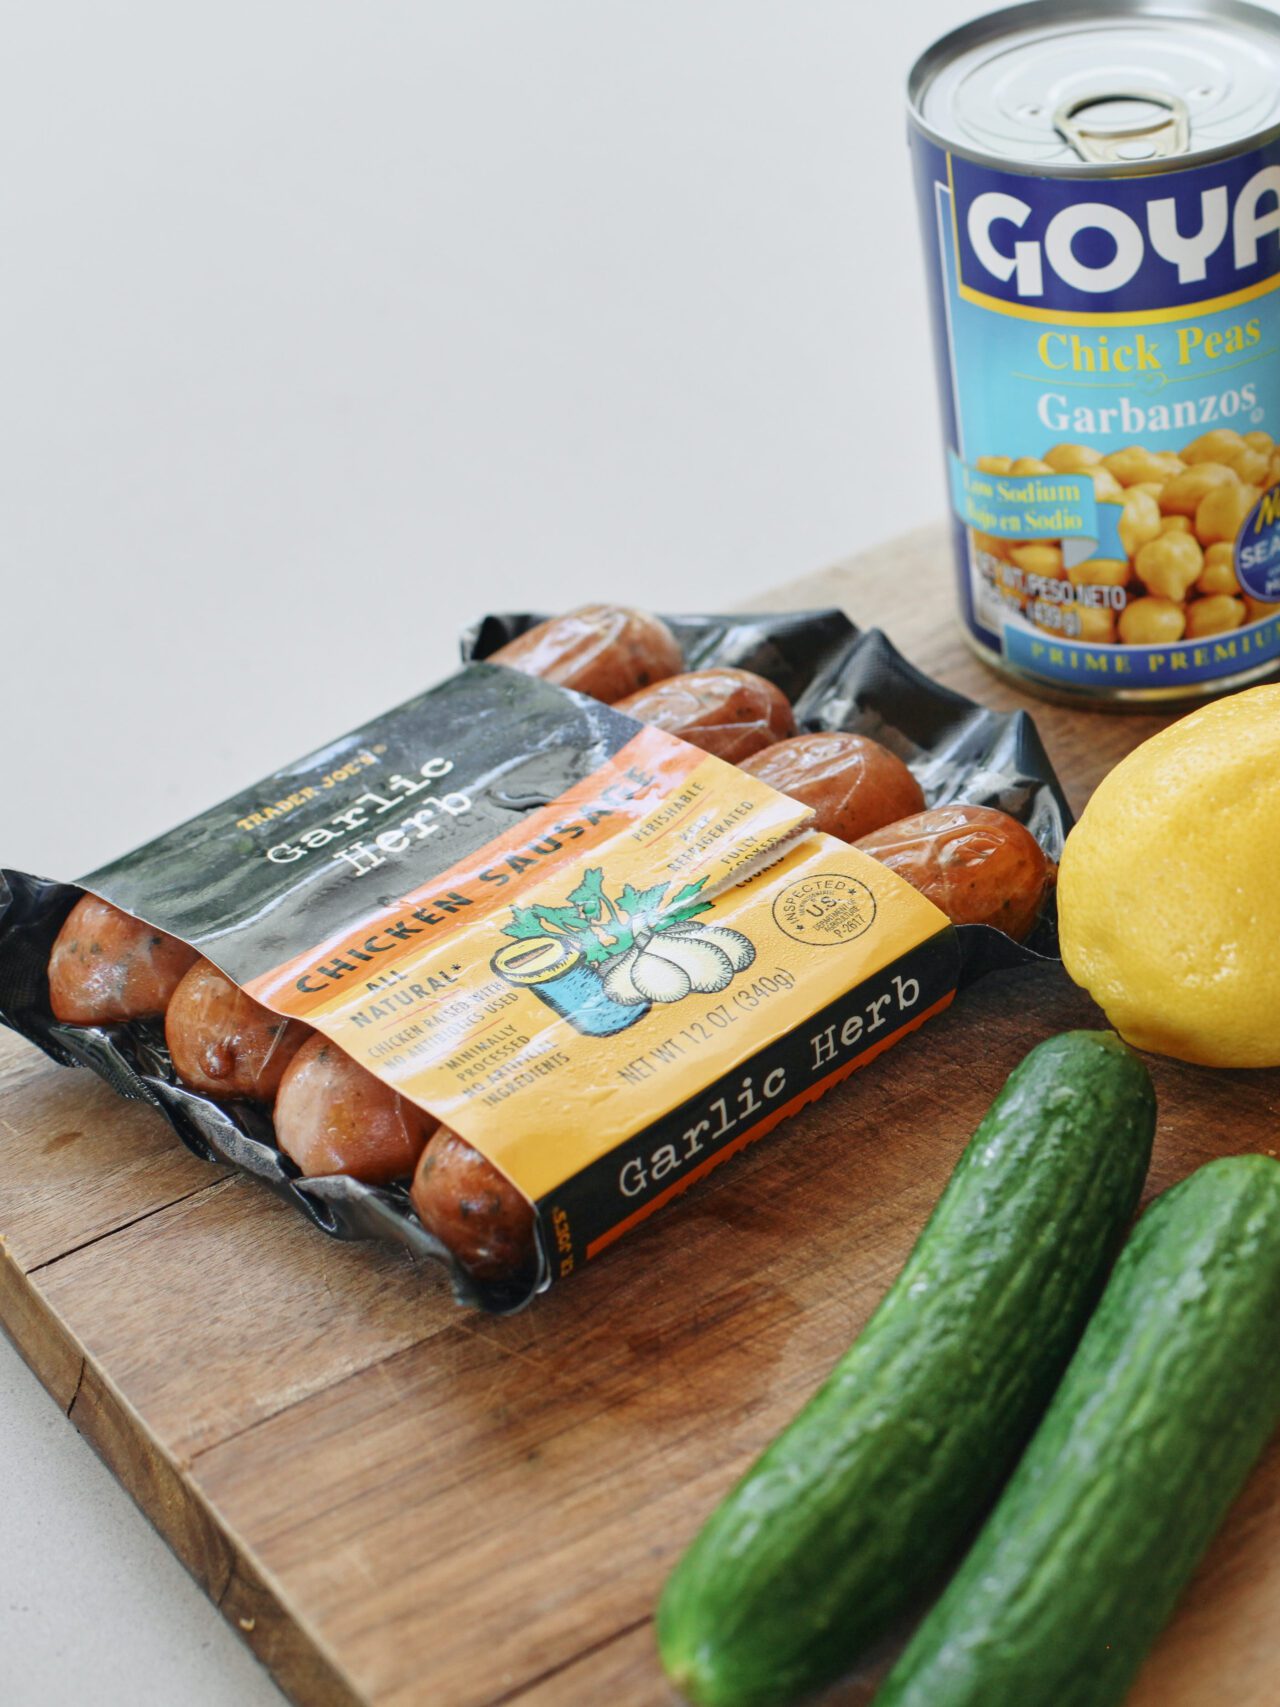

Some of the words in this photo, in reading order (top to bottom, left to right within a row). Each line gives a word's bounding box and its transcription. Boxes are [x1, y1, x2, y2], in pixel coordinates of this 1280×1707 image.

[1038, 331, 1160, 373] Chick
[1178, 317, 1262, 365] Peas
[1037, 382, 1257, 434] Garbanzos
[996, 481, 1080, 503] Sodium
[1024, 509, 1082, 531] Sodio
[1077, 582, 1127, 611] NETO
[1031, 641, 1131, 673] PRIME
[236, 785, 321, 832] TRADER
[266, 757, 454, 865] Garlic
[333, 790, 472, 877] Herb
[631, 782, 705, 842] PERISHABLE
[667, 801, 754, 872] REFRIGERATED
[721, 835, 758, 865] FULLY
[295, 891, 474, 994] CHICKEN
[479, 766, 654, 888] SAUSAGE
[783, 880, 846, 925] INSPECTED
[806, 896, 841, 917] U.S.
[366, 970, 408, 993] ALL
[367, 1025, 424, 1059] CHICKEN
[423, 1001, 471, 1029] RAISED
[468, 979, 507, 1003] WITH
[384, 1055, 406, 1071] NO
[408, 1013, 485, 1058] ANTIBIOTICS
[487, 992, 519, 1015] USED
[617, 1057, 659, 1087] NET
[650, 1038, 686, 1065] WT
[680, 1019, 710, 1046] 12
[713, 1004, 738, 1030] OZ
[732, 966, 797, 1013] (340g)
[457, 1035, 531, 1082] PROCESSED
[462, 1082, 486, 1098] NO
[487, 1040, 559, 1089] ARTIFICIAL
[481, 1052, 570, 1107] INGREDIENTS
[619, 1066, 787, 1197] Garlic
[810, 975, 921, 1071] Herb
